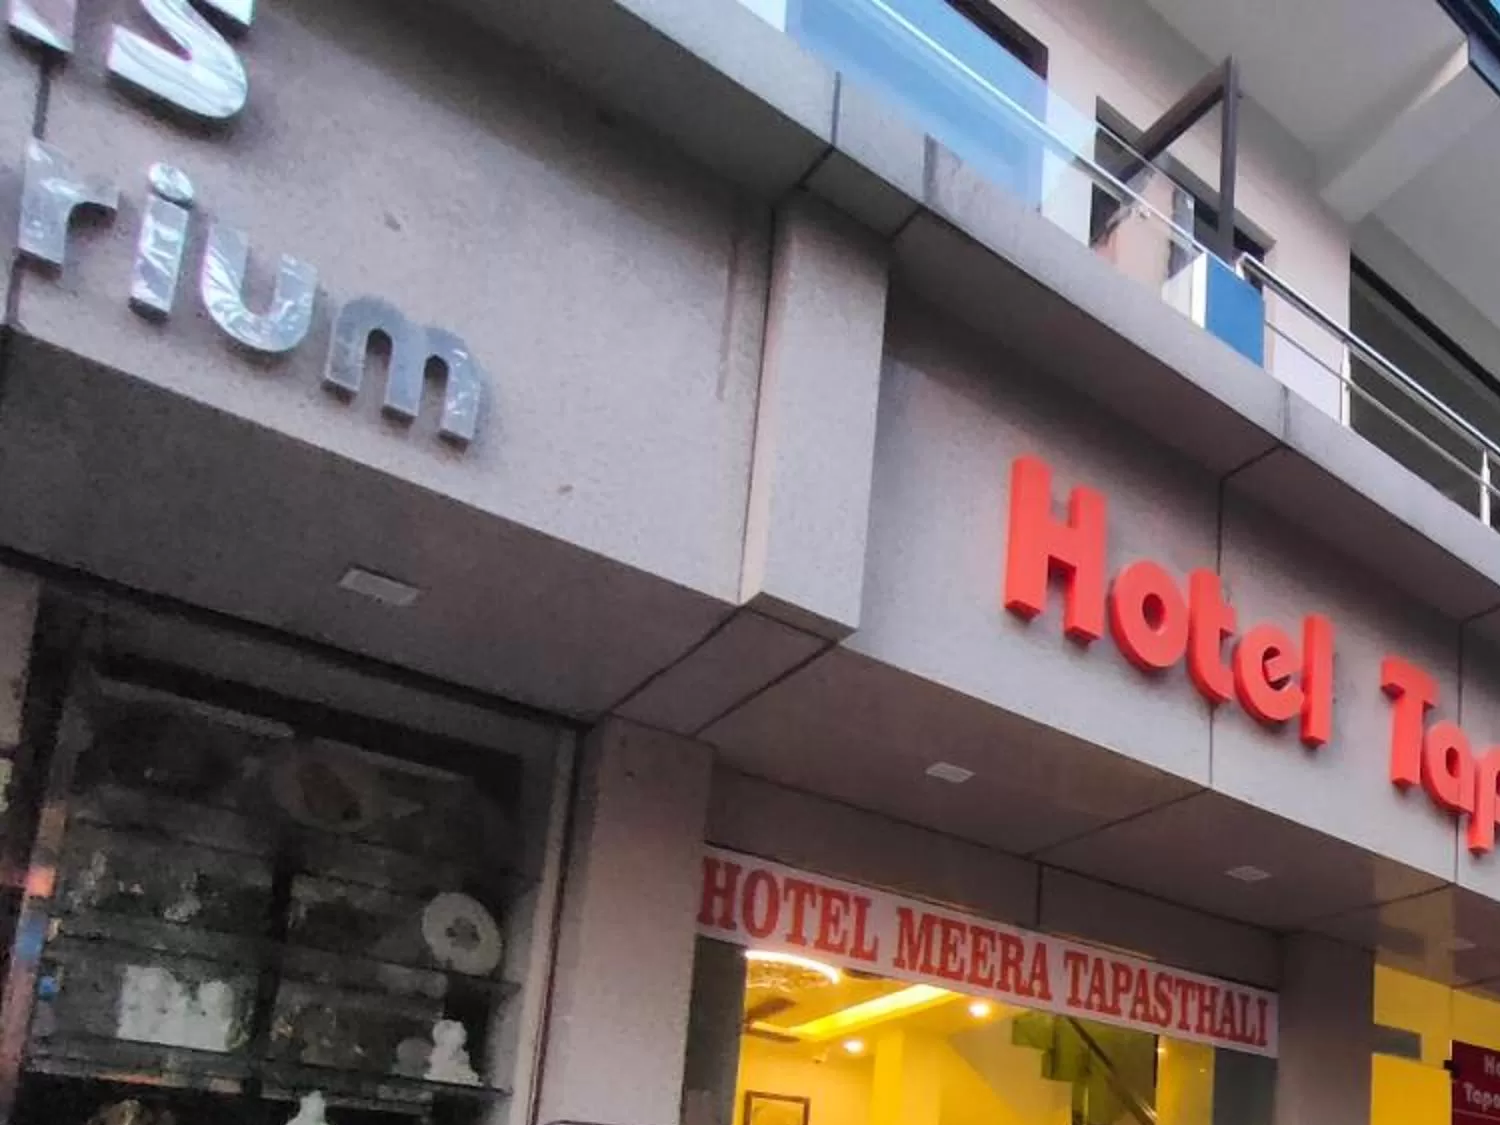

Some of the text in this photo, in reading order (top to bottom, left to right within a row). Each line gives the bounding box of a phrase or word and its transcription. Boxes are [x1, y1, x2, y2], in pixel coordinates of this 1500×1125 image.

[18, 138, 482, 446] rium
[1005, 455, 1335, 746] Hotel
[696, 855, 1268, 1047] HOTEL MEERA TAPASTHALI
